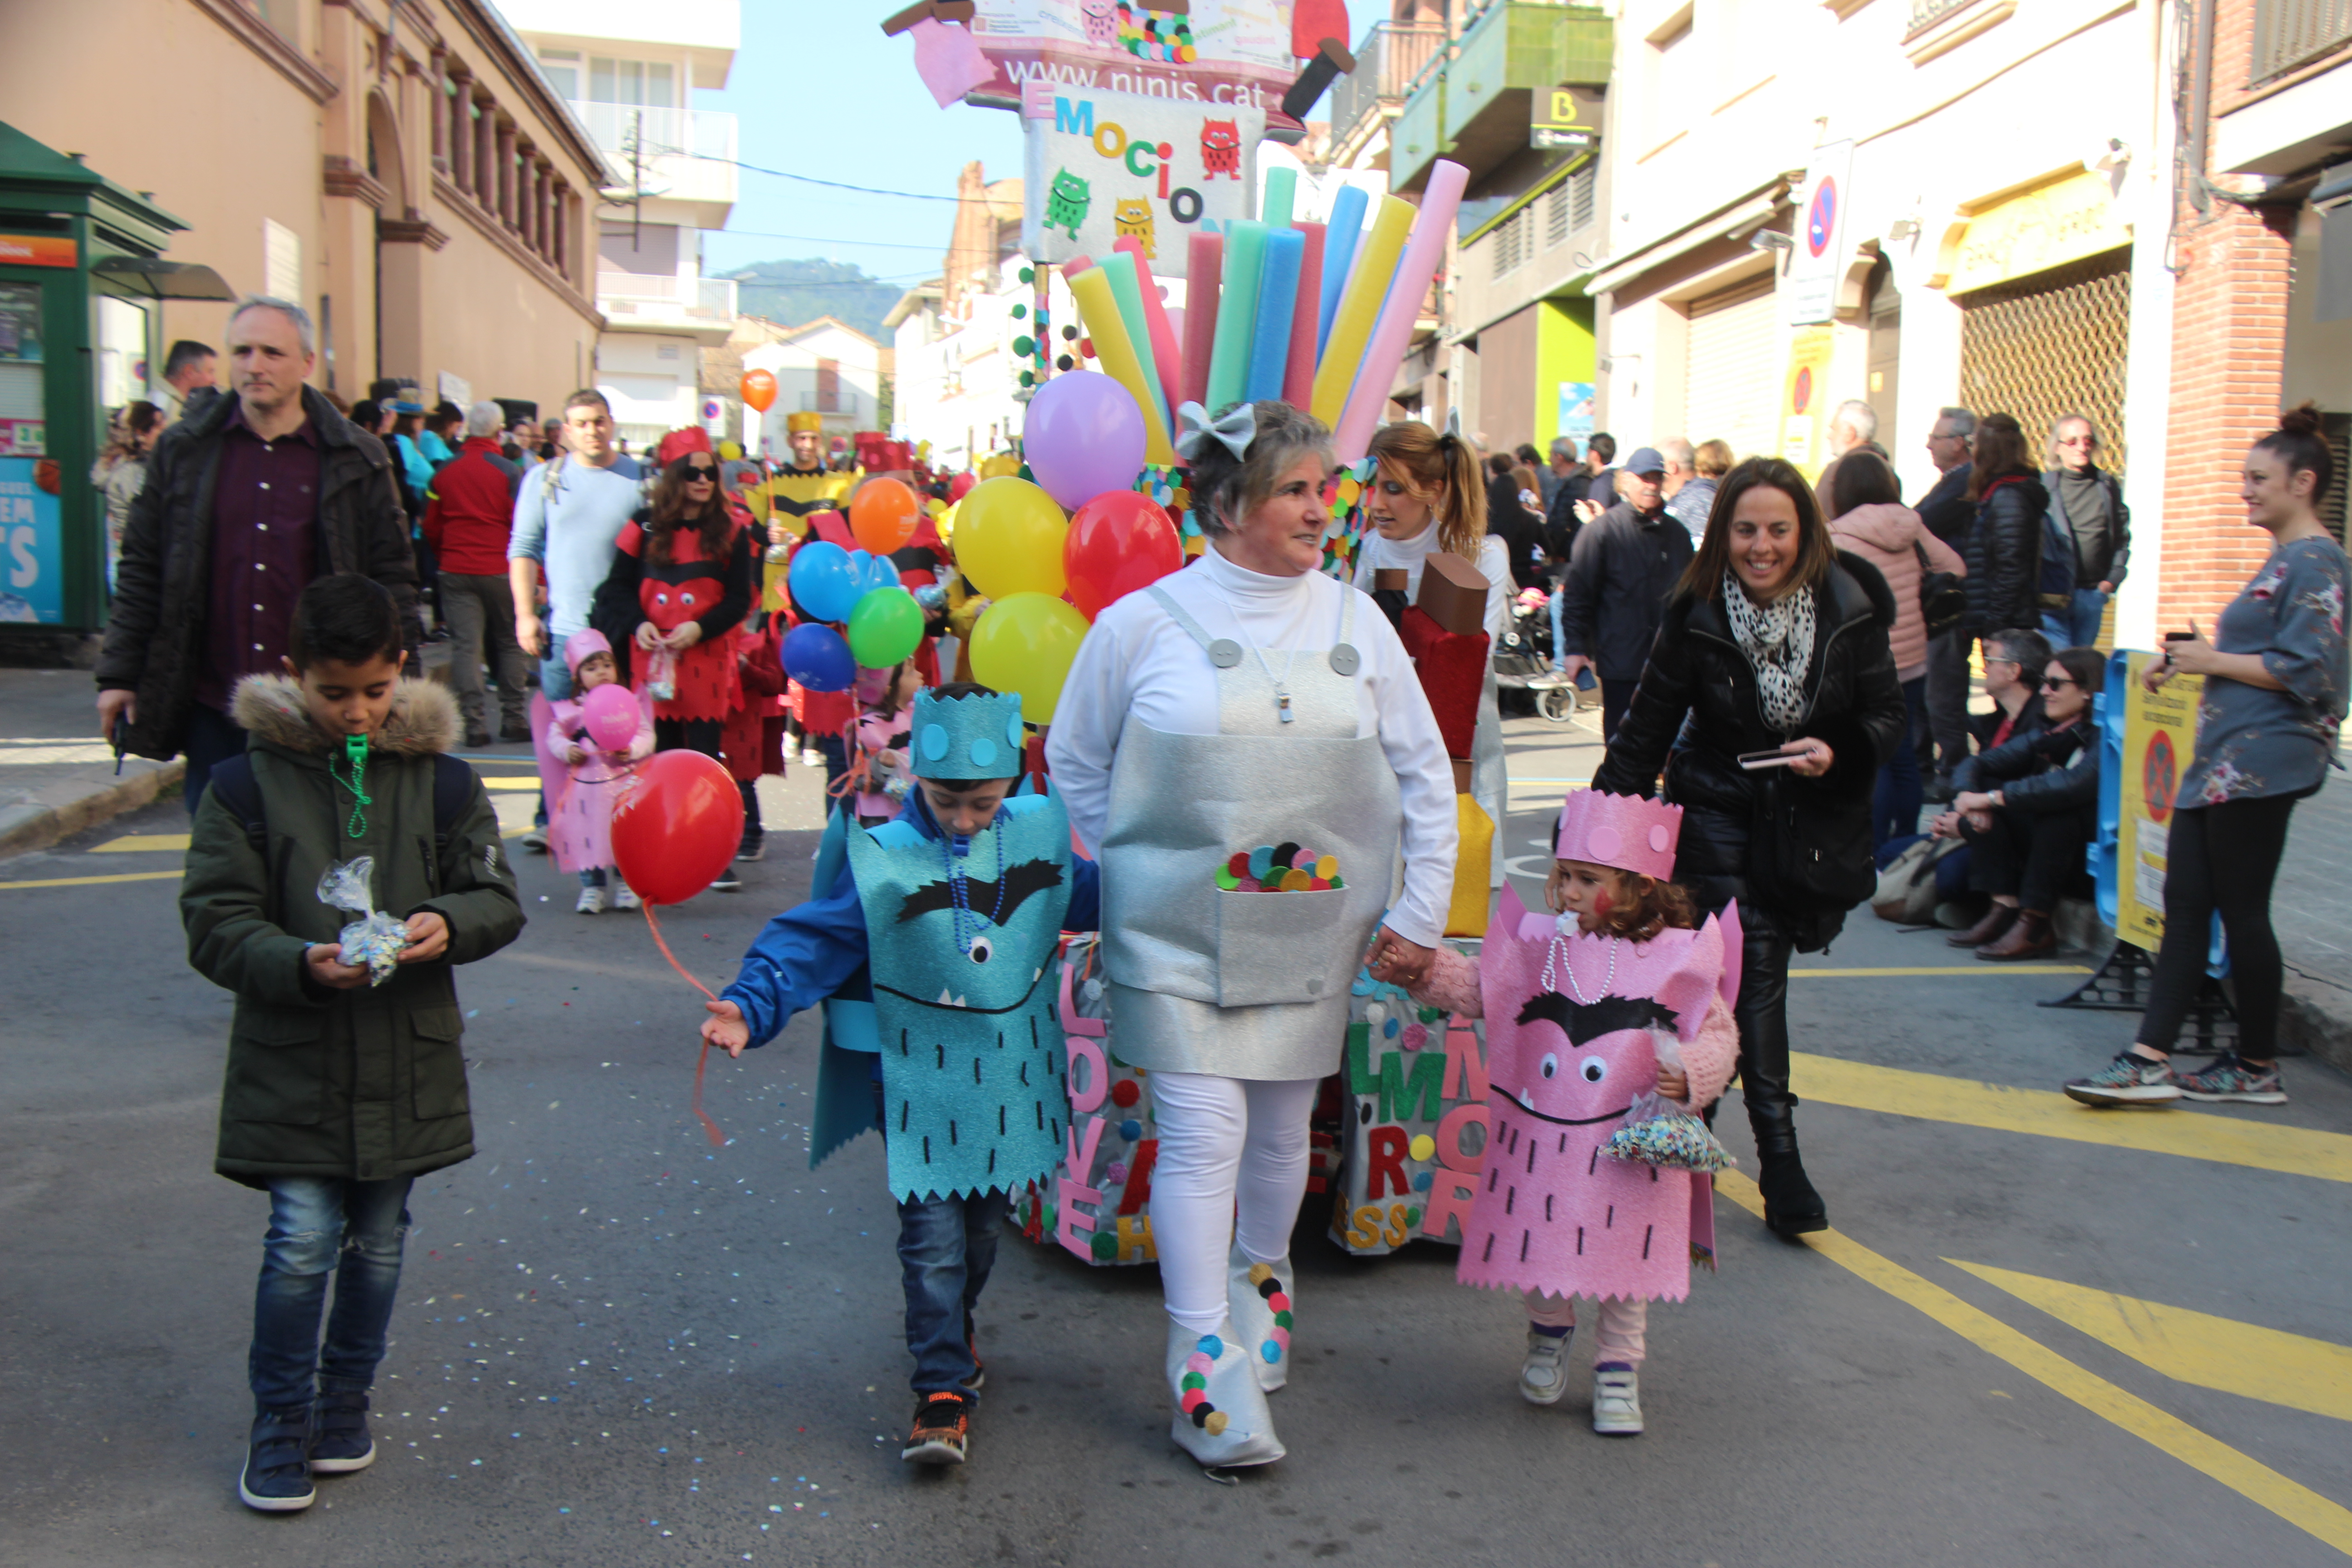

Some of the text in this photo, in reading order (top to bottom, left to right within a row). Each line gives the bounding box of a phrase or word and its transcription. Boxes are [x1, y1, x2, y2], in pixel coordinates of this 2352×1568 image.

[1194, 18, 1238, 40] stimant
[1004, 60, 1266, 109] www.ninis.cat
[1551, 91, 1578, 123] B
[1058, 962, 1108, 1262] LOVE
[1422, 1012, 1491, 1238] MOR
